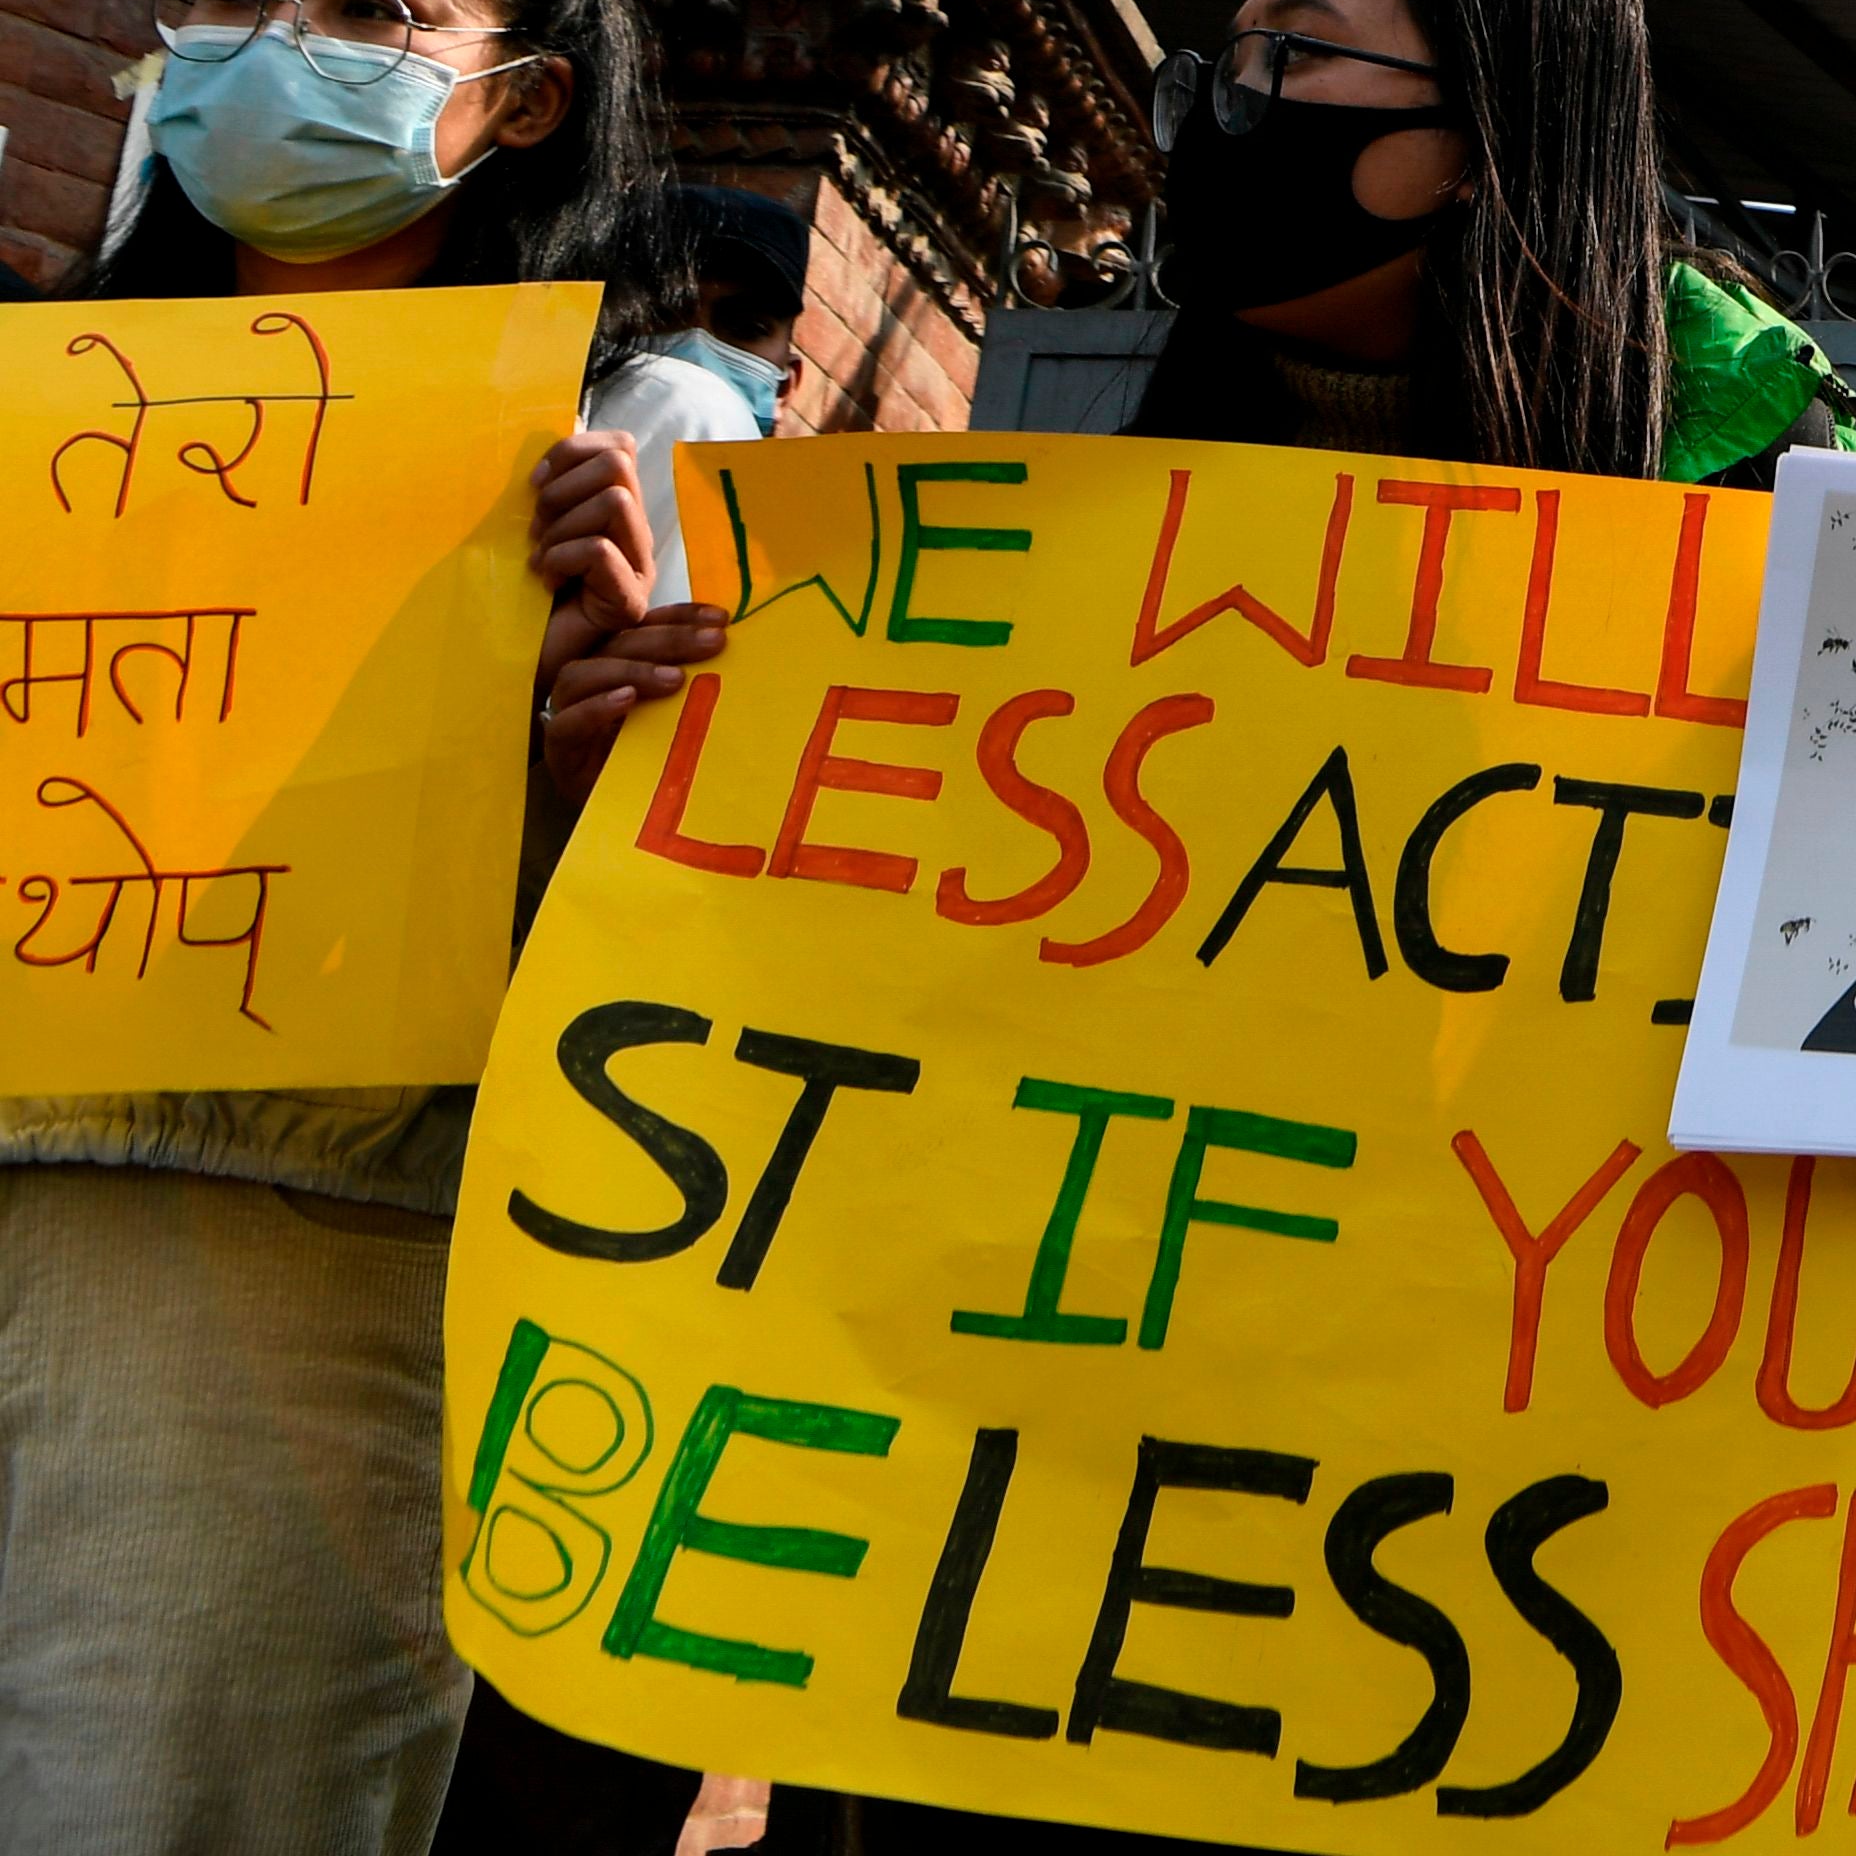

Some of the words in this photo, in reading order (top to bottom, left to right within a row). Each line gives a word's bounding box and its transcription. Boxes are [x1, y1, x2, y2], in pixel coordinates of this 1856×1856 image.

[718, 461, 1033, 647] WE
[1130, 470, 1749, 729] WILL
[634, 673, 1215, 967] LESS
[507, 1000, 920, 1292] ST
[950, 1076, 1357, 1351] IF
[461, 1317, 902, 1690] BE
[895, 1426, 1623, 1817] LESS
